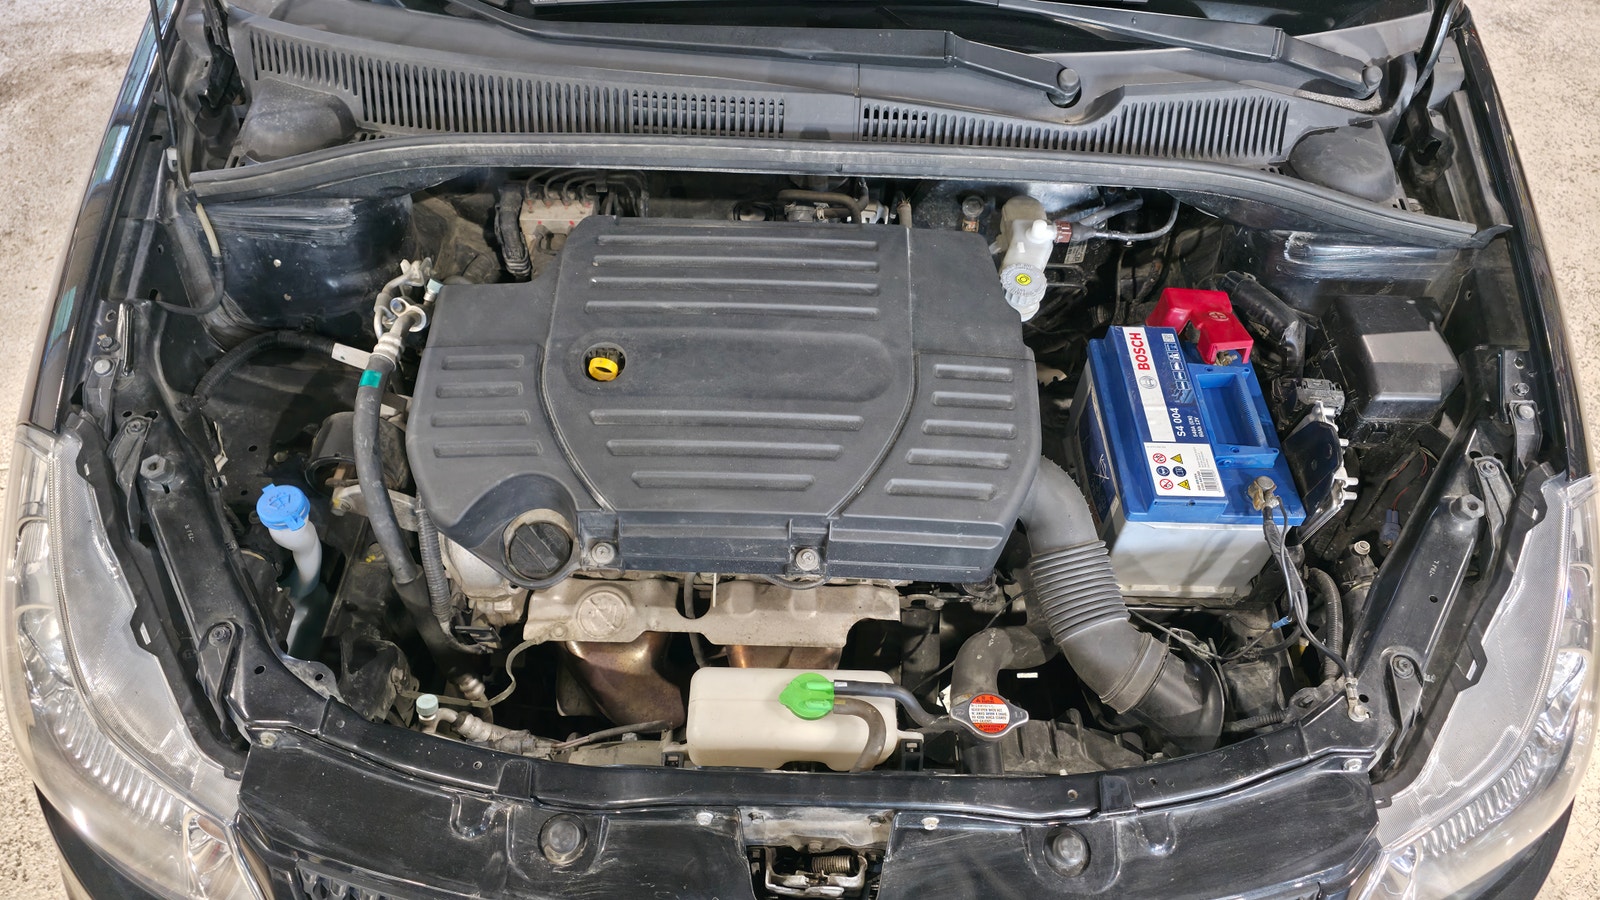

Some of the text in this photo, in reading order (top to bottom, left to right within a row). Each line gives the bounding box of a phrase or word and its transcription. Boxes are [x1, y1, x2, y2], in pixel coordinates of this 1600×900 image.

[1129, 333, 1150, 370] BOSCH
[1170, 407, 1186, 437] S4 004
